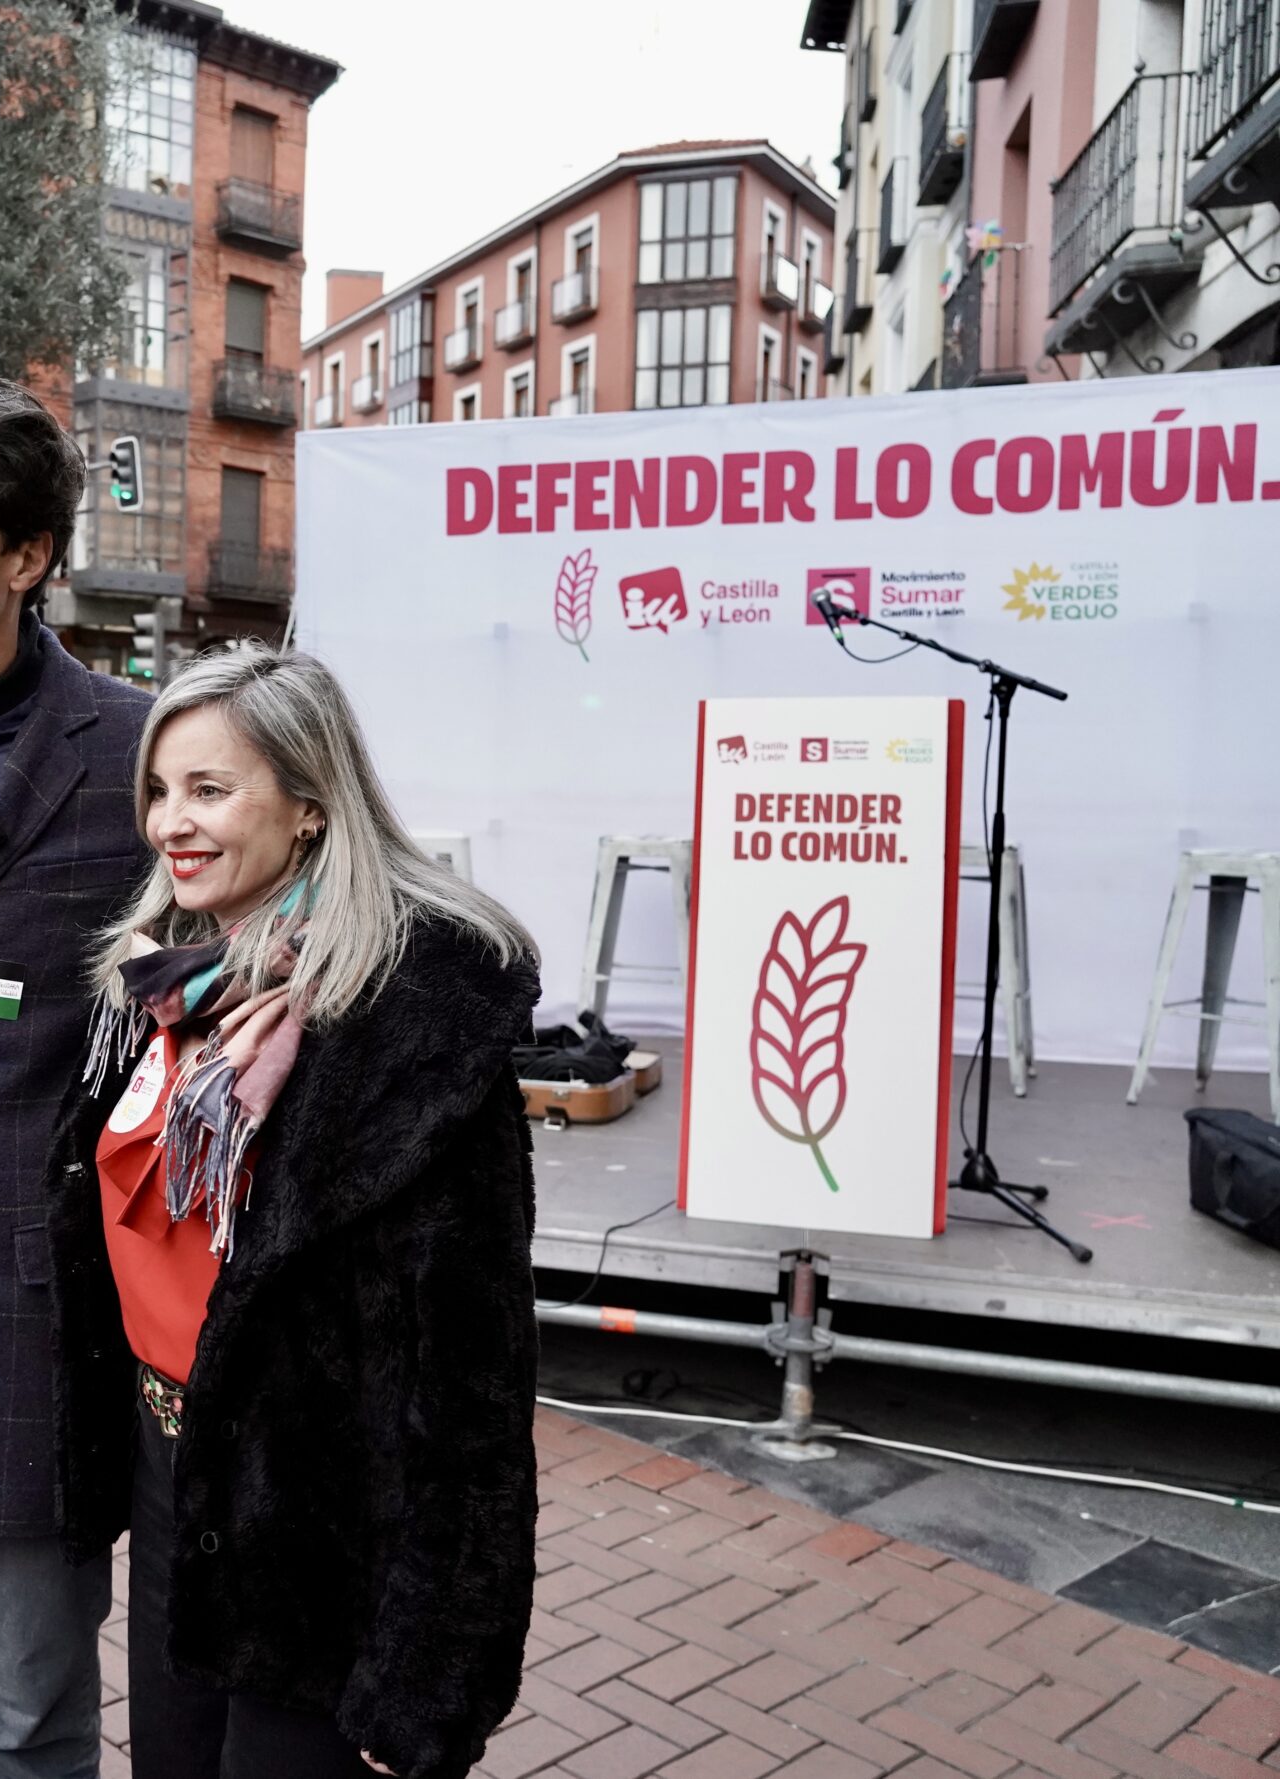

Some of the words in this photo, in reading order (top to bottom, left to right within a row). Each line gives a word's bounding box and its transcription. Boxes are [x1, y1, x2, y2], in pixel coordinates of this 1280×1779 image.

[447, 450, 816, 536] DEFENDER
[834, 441, 932, 520] LO
[950, 408, 1280, 515] COMÚN.
[881, 571, 966, 583] Movimiento
[700, 579, 779, 600] Castilla
[881, 586, 965, 604] Sumar
[1031, 584, 1118, 601] VERDES
[700, 608, 711, 628] y
[720, 604, 770, 623] León
[1051, 603, 1118, 620] EQUO
[806, 741, 823, 761] S
[735, 793, 902, 825] DEFENDER
[734, 831, 772, 861] LO
[781, 825, 908, 864] COMÚN.
